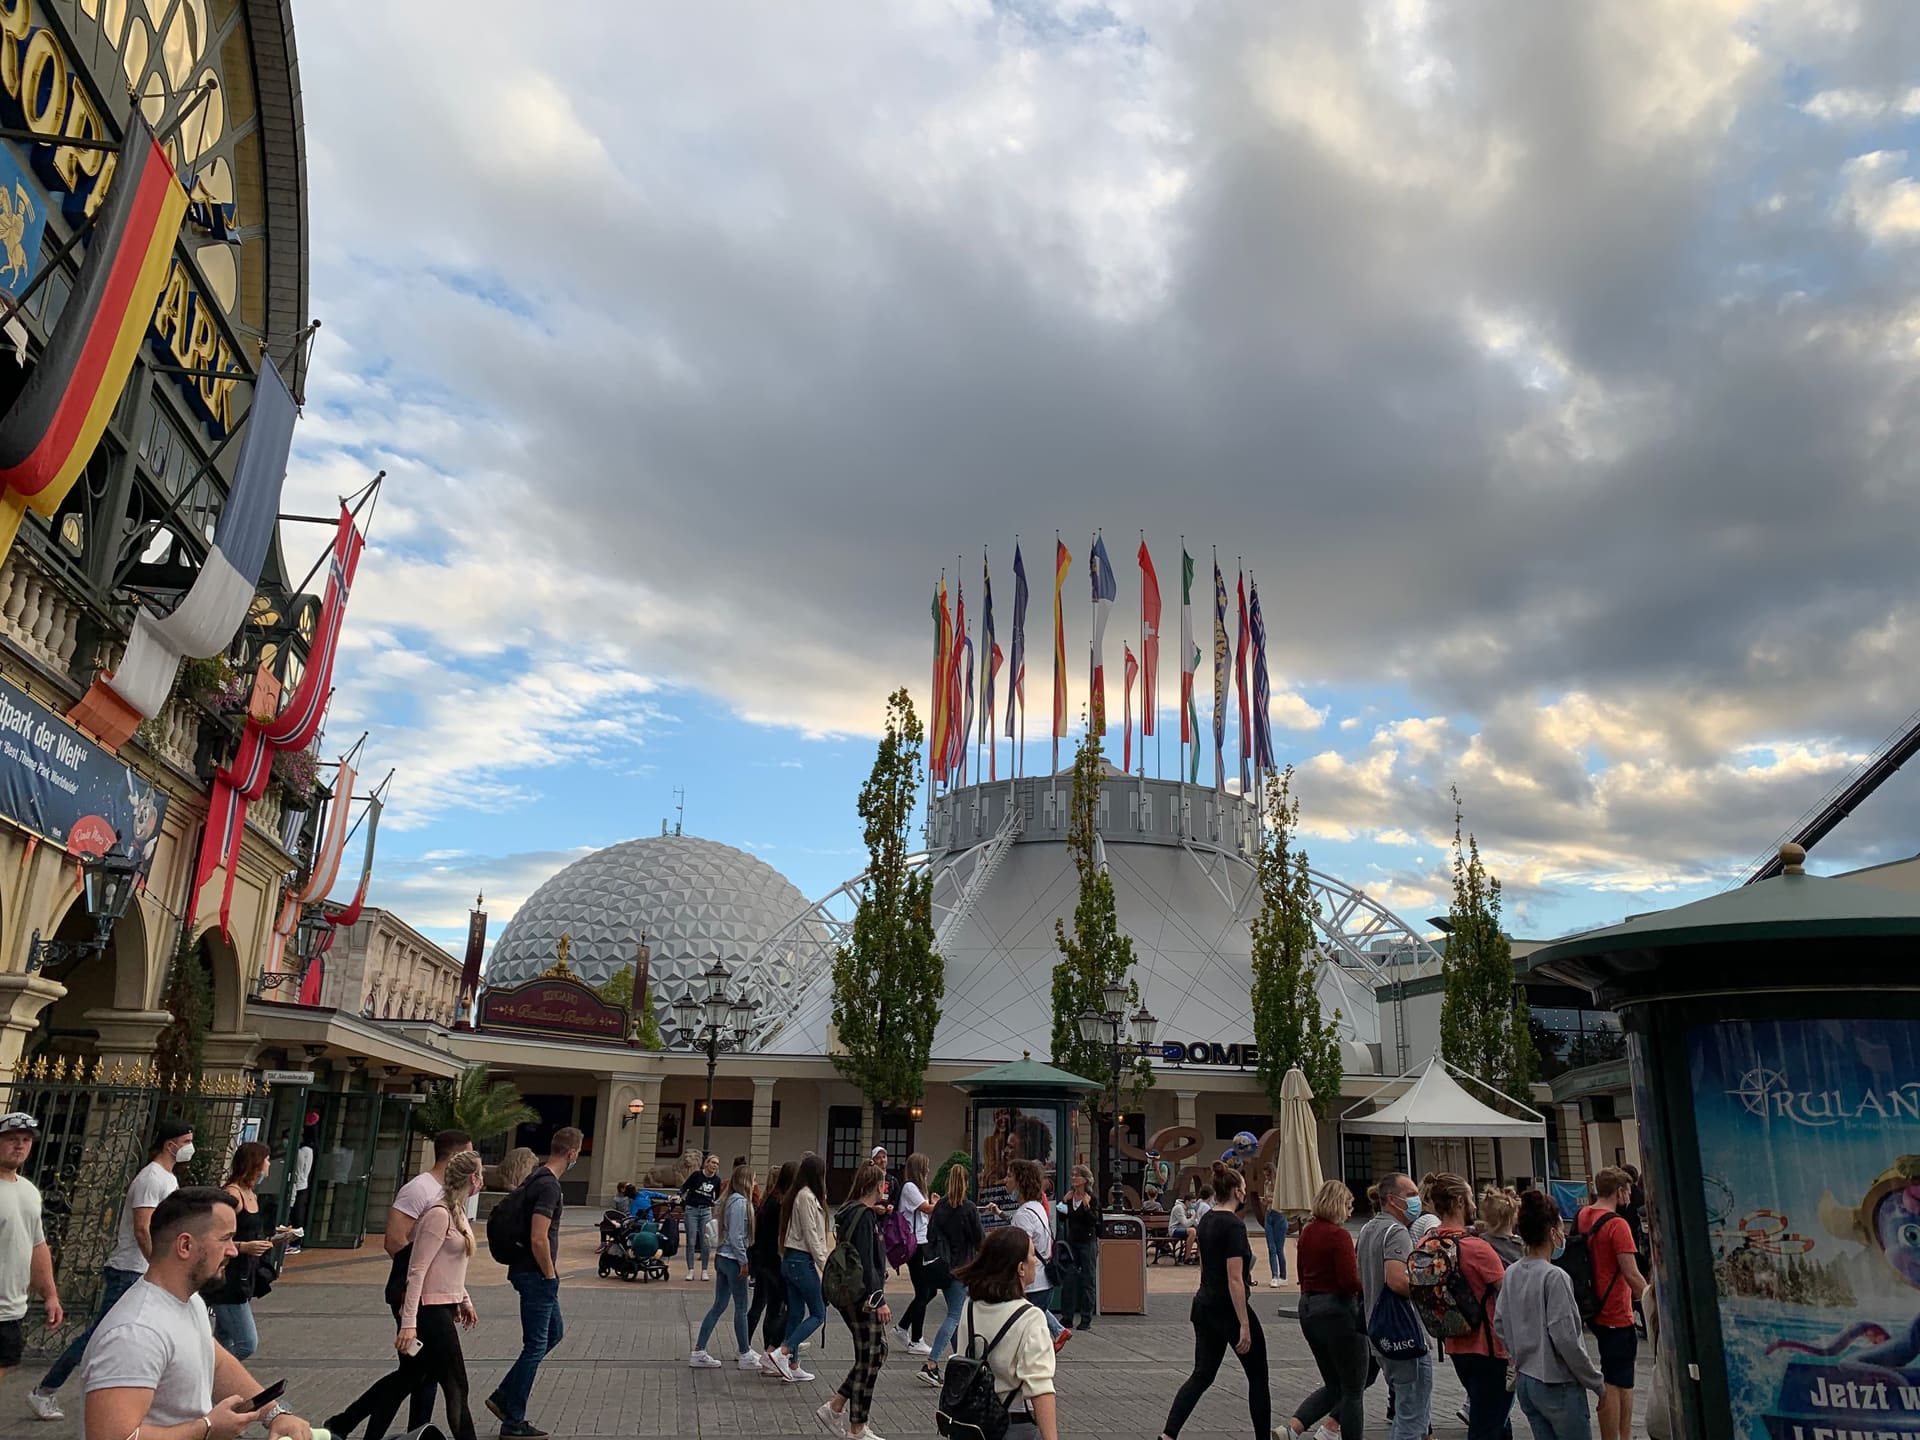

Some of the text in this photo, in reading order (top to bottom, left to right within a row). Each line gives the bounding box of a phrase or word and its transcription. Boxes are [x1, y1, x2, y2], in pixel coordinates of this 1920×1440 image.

[155, 259, 242, 436] ARK
[34, 722, 56, 753] der
[18, 750, 38, 771] Theme
[36, 762, 51, 779] Park
[1163, 1041, 1259, 1066] DOME
[1393, 1338, 1415, 1351] MSC
[1810, 1376, 1890, 1410] Jetzt
